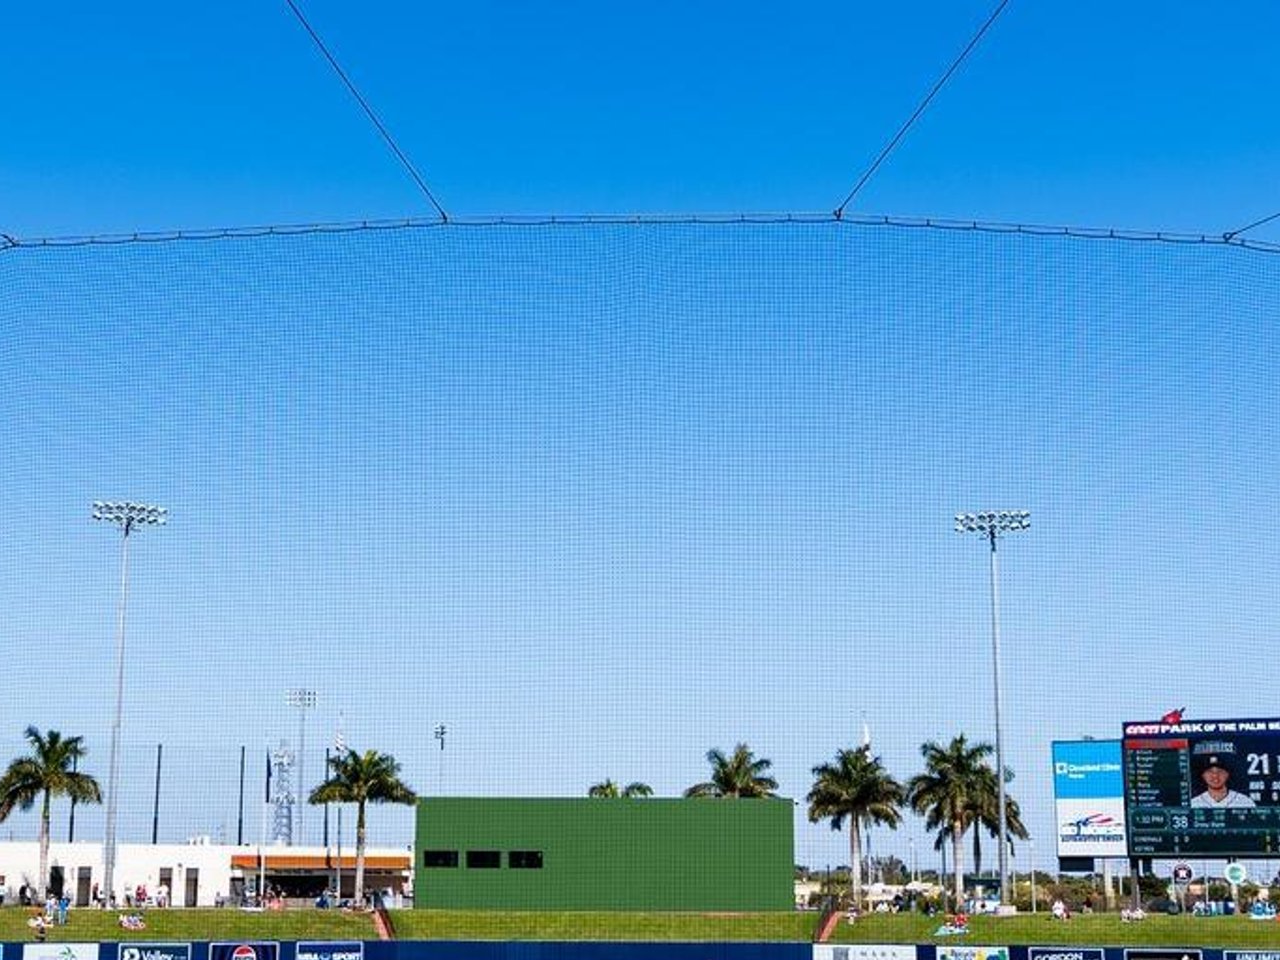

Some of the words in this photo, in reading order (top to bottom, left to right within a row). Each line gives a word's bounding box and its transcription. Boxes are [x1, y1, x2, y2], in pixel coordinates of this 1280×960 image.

[1161, 724, 1203, 733] PARK
[1219, 723, 1236, 731] THE
[1239, 722, 1266, 730] PALM
[1247, 753, 1270, 775] 21
[1172, 816, 1188, 829] 38
[332, 953, 361, 960] SPORT
